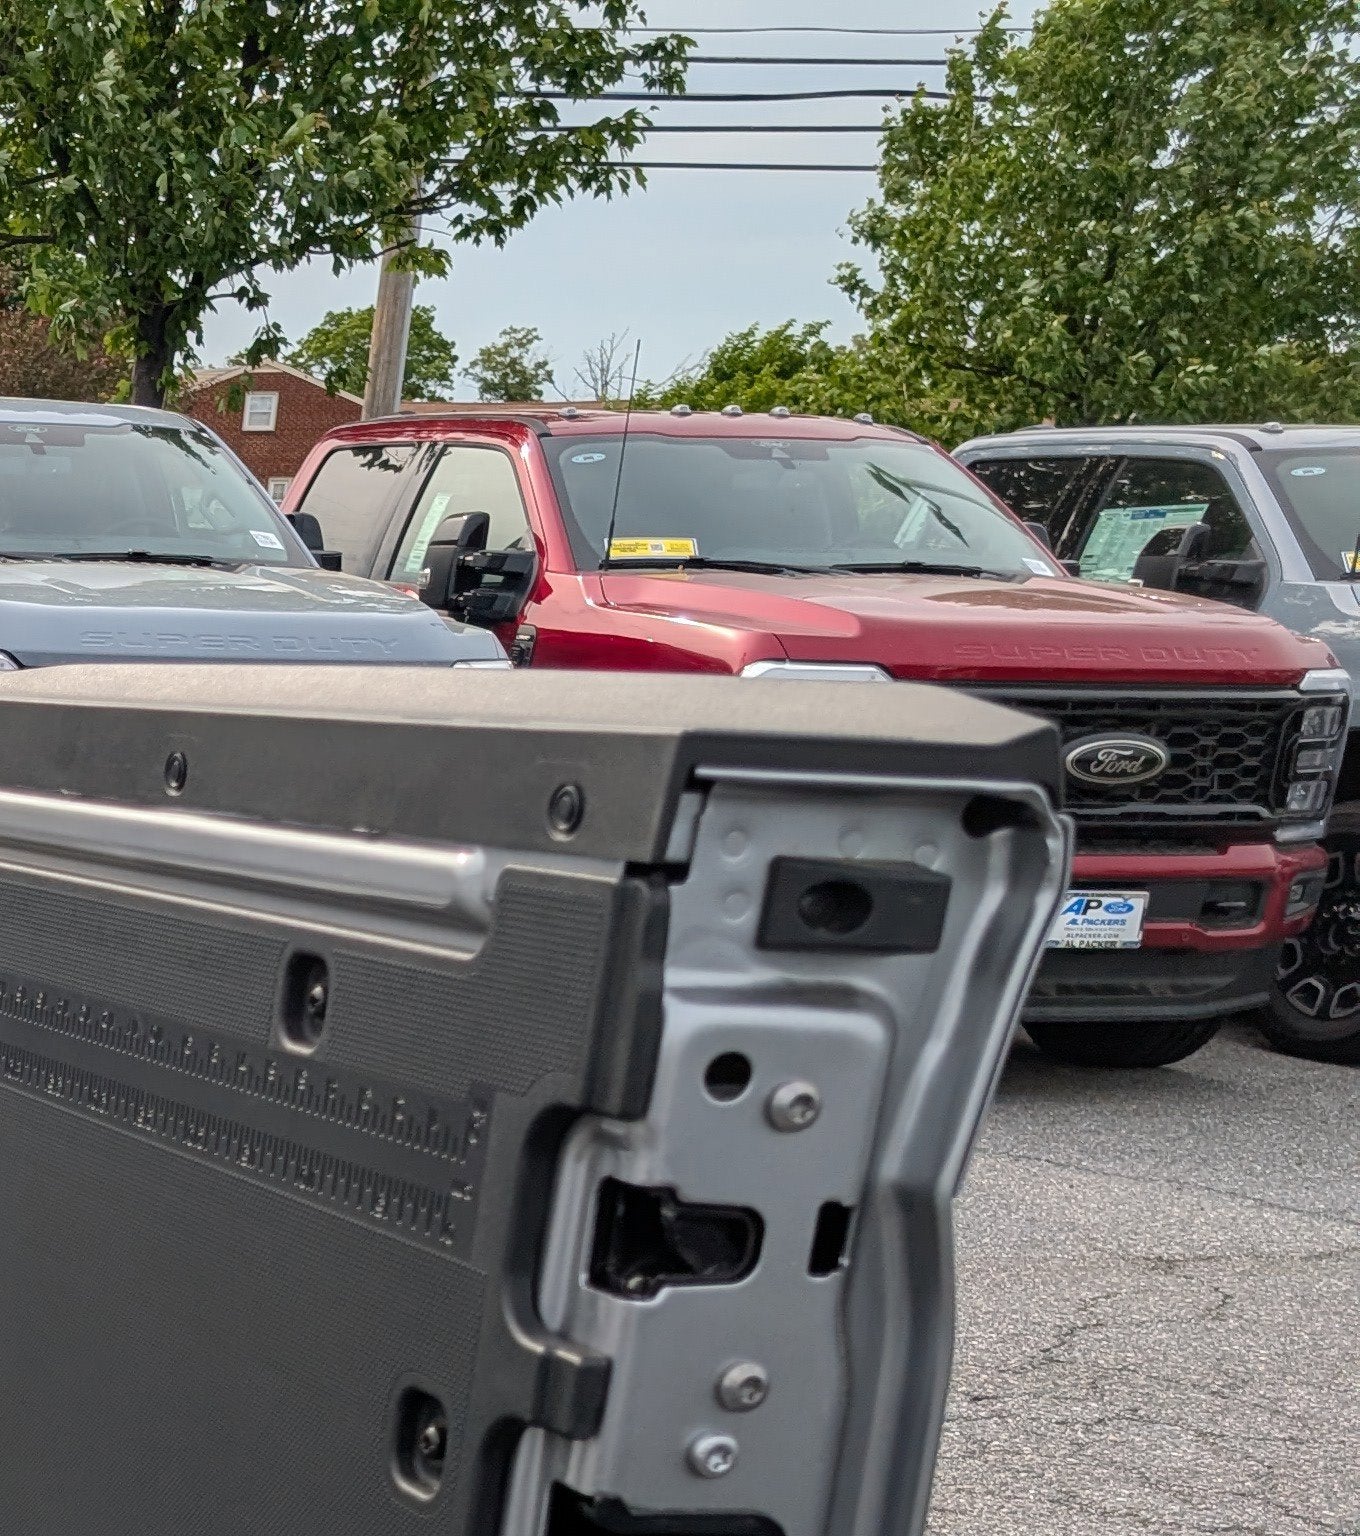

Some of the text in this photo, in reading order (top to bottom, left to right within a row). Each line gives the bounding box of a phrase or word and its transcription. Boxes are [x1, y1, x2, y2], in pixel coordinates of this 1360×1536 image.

[79, 630, 399, 654] SUPER DUTY
[952, 643, 1258, 664] SUPER DUTY
[1089, 748, 1146, 774] Ford
[1060, 898, 1103, 915] AP
